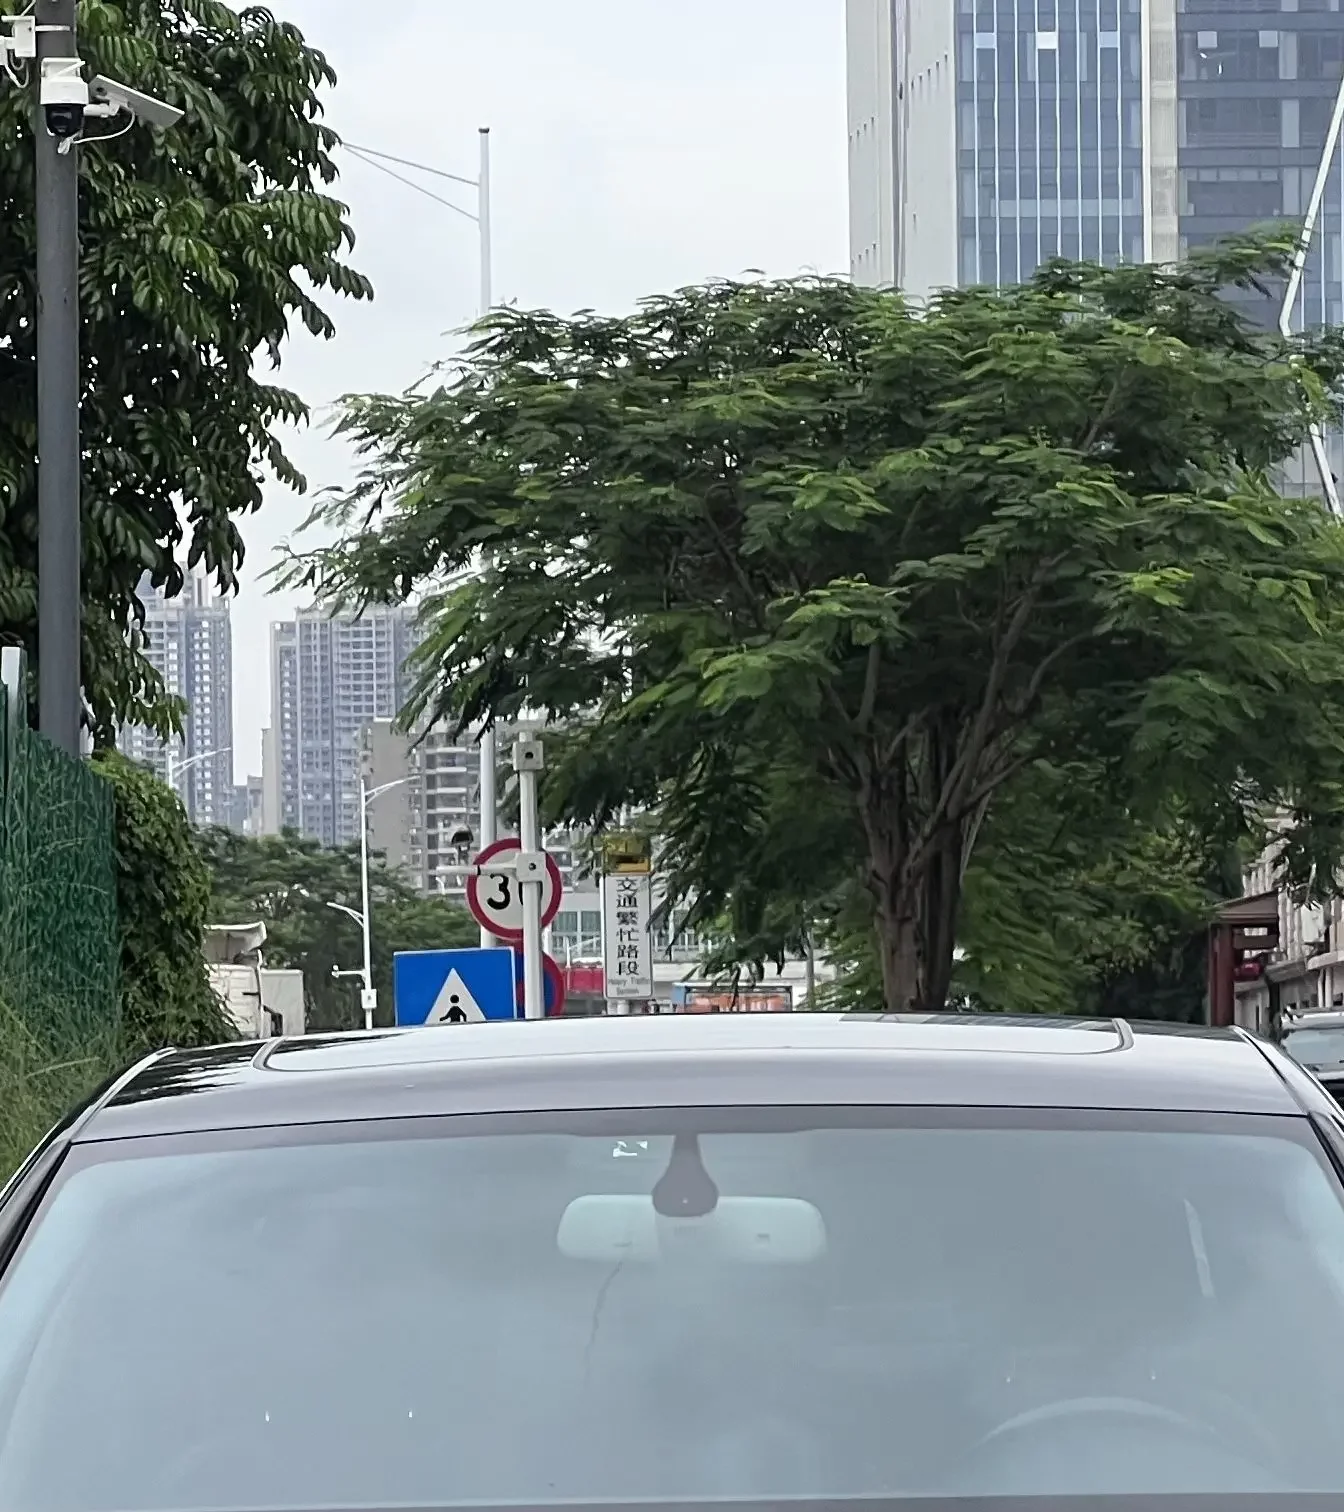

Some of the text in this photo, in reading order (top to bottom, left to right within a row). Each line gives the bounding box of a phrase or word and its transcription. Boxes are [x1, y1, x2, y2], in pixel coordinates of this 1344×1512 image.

[616, 877, 640, 976] 交通繁忙路段
